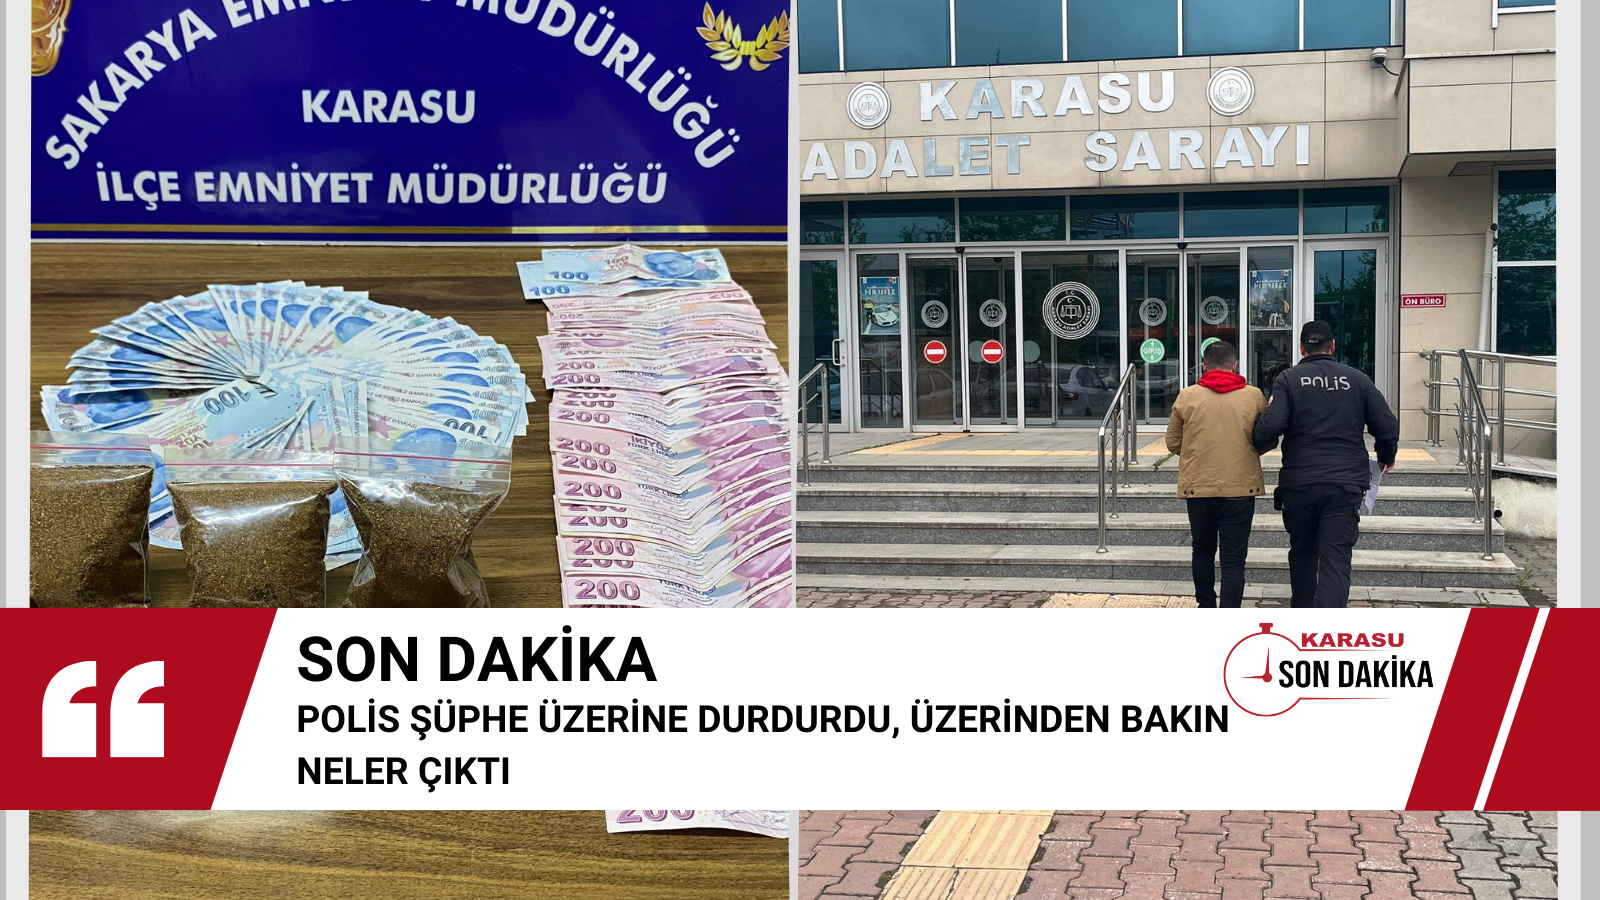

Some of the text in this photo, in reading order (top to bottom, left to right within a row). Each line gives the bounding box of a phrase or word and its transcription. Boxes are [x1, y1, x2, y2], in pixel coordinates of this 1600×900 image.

[46, 9, 217, 170] SAKARYA
[919, 71, 1177, 121] KARASU
[302, 89, 475, 123] KARASU
[802, 124, 1310, 181] ADALET SARAYI
[96, 162, 667, 210] İLÇE EMNİYET MÜDÜRLÜĞÜ
[549, 271, 589, 281] 100
[528, 285, 570, 296] 100
[1405, 297, 1442, 305] ÖN BÜRO
[1142, 346, 1163, 355] GİRİŞ
[556, 361, 595, 371] 200
[551, 373, 601, 386] 200
[1300, 376, 1351, 391] POLİS
[203, 385, 251, 415] 100
[557, 409, 611, 424] 200
[187, 423, 207, 436] TÜRK
[556, 437, 611, 456] 200
[560, 454, 617, 474] 200
[563, 480, 622, 500] 200
[572, 537, 636, 556] 200
[574, 579, 641, 601] 200
